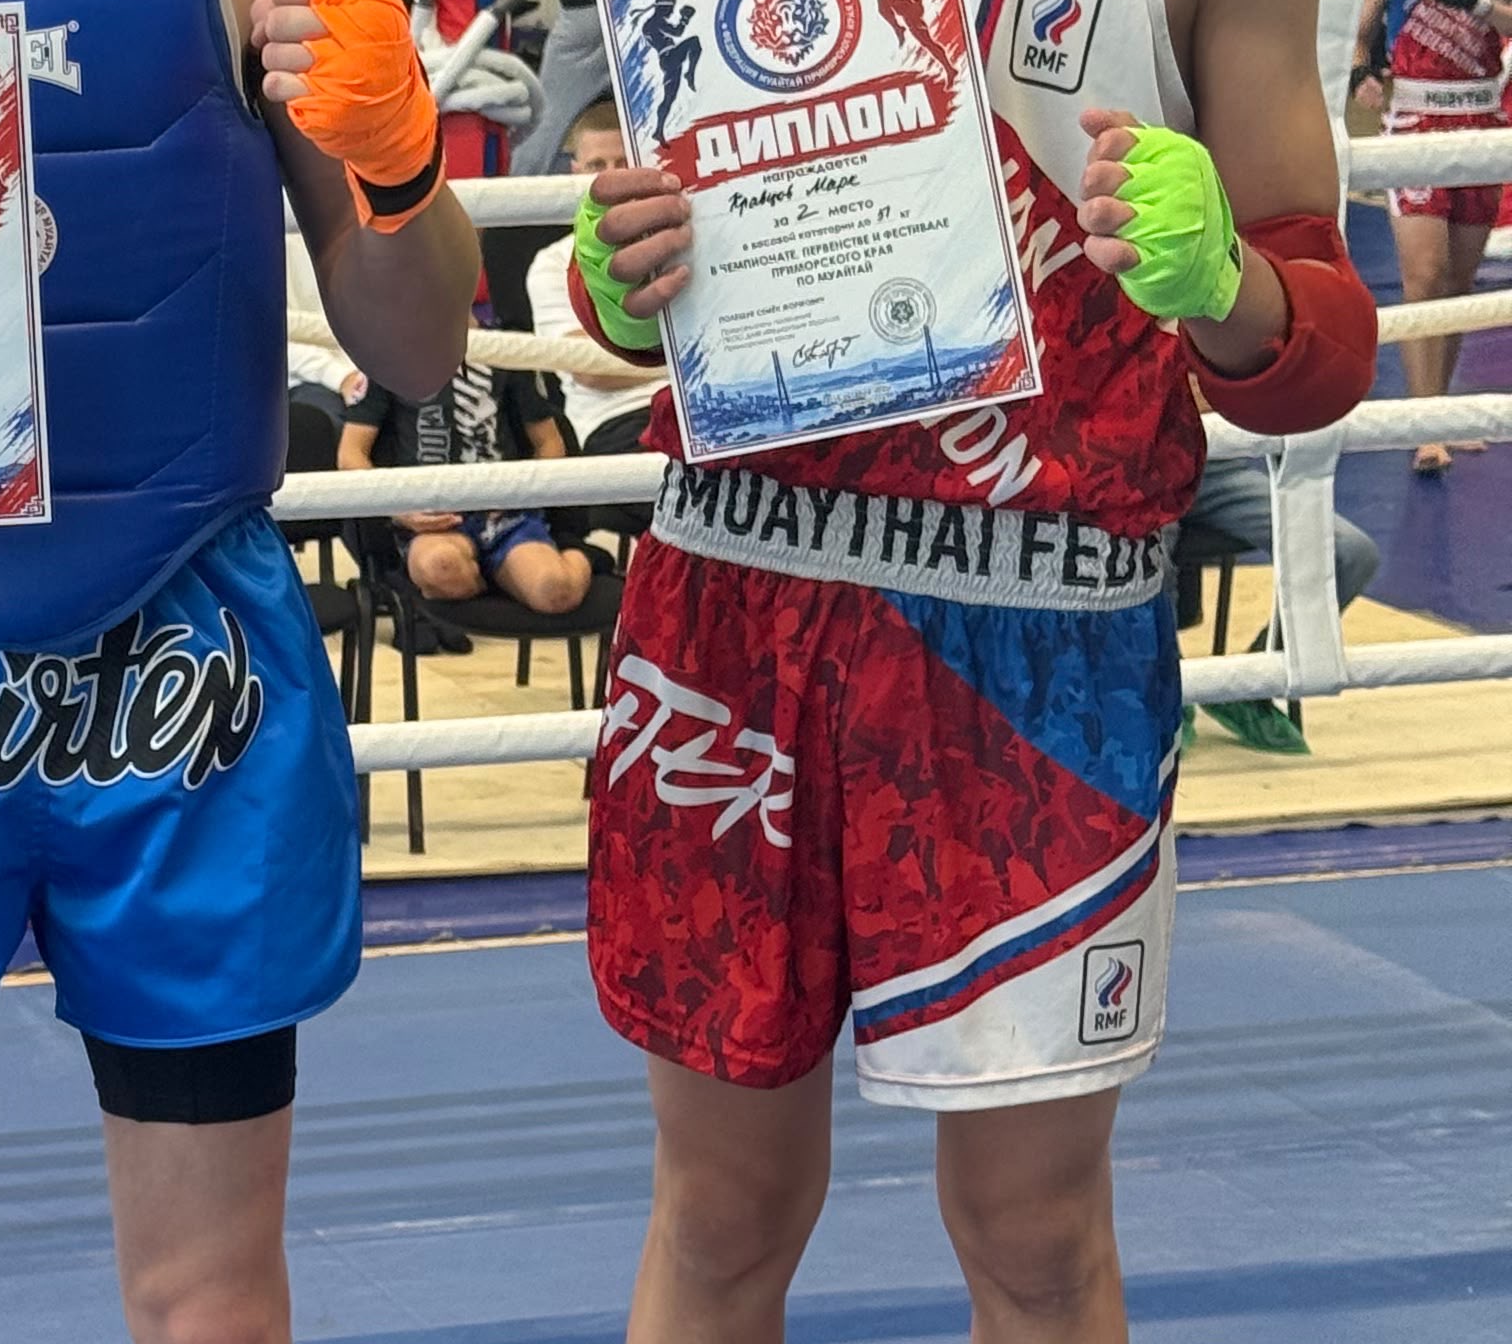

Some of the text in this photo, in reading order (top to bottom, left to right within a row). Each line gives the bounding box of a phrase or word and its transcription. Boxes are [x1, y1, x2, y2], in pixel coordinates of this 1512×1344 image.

[1023, 45, 1068, 74] RMF
[695, 83, 936, 178] ДИПЛОМ
[763, 154, 868, 184] награждается
[806, 174, 861, 196] Марк
[773, 199, 874, 228] за 2 место
[802, 235, 869, 258] ПЕРВЕНСТВЕ
[873, 232, 881, 242] И
[884, 218, 950, 239] ФЕСТИВАЛЕ
[771, 244, 893, 278] ПРИМОРСКОГО КРАЯ
[796, 263, 874, 287] ПО МУАЙТАЙ
[1094, 1009, 1128, 1030] RMF
